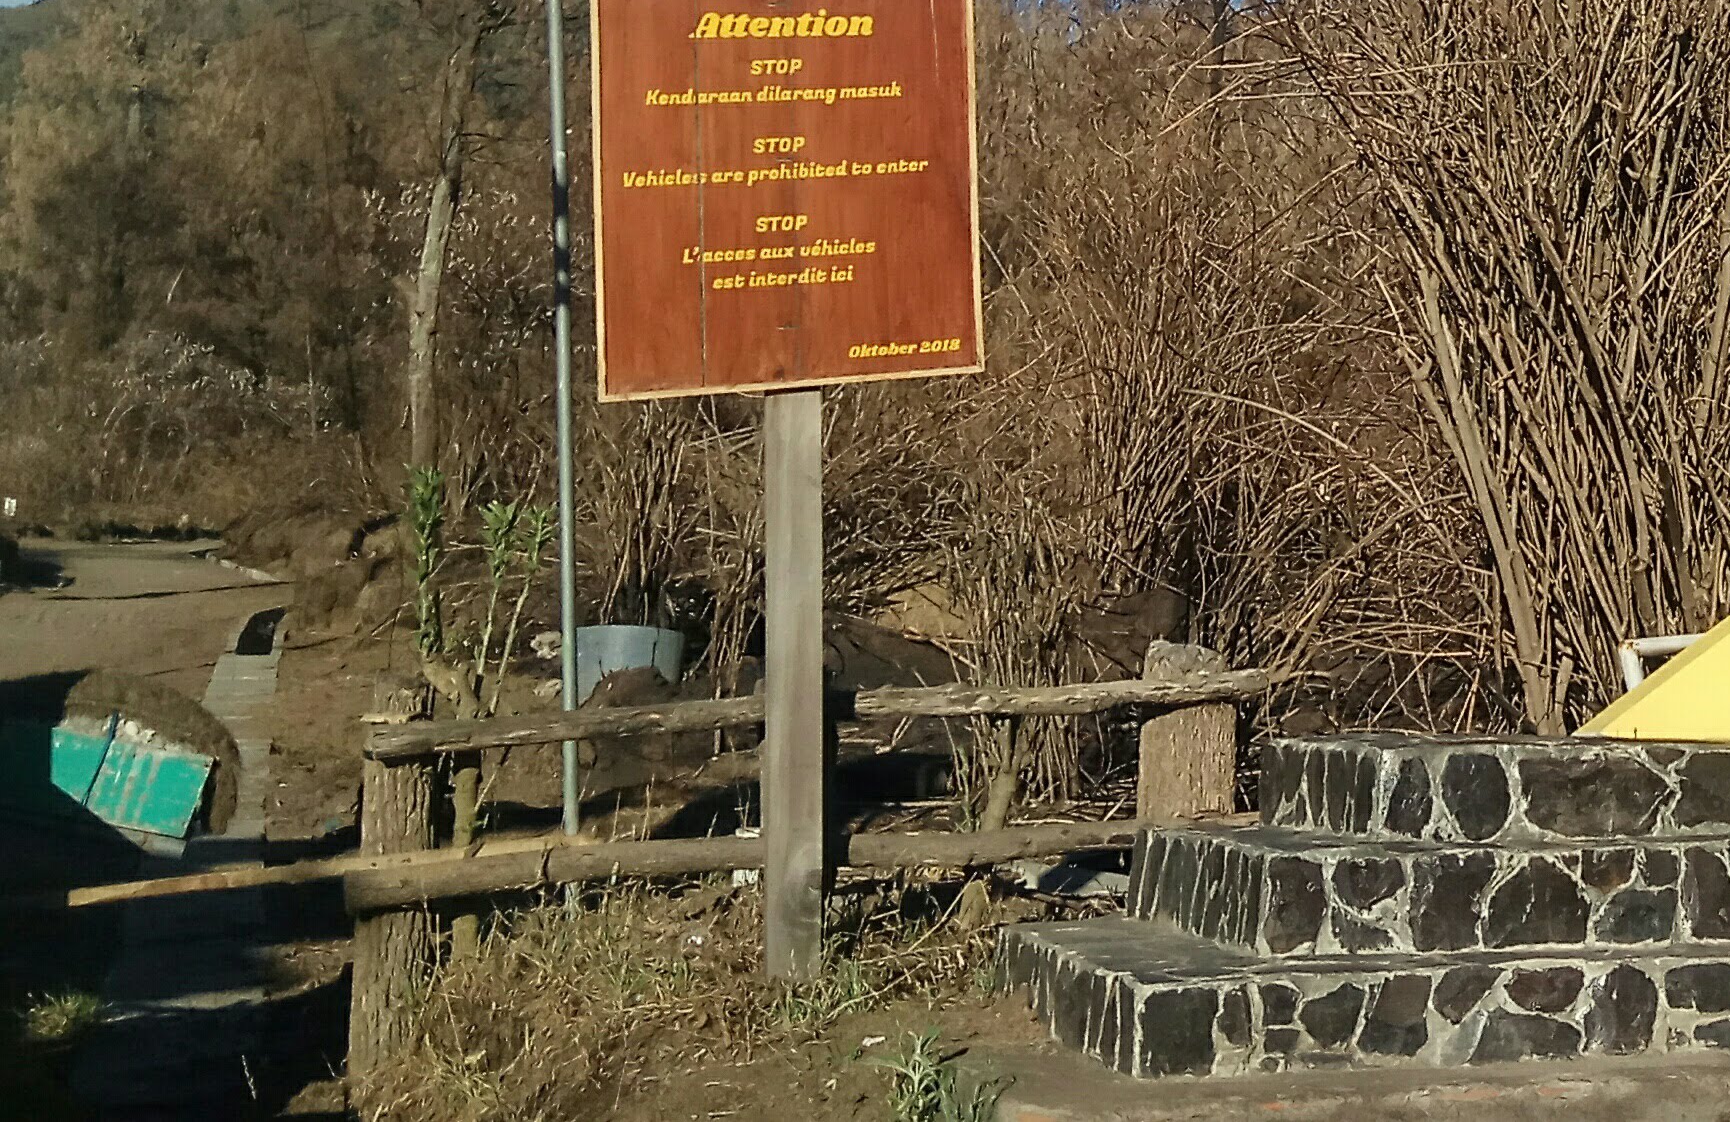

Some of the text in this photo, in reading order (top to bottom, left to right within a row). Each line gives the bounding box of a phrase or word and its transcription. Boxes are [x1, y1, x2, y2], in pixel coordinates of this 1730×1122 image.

[688, 8, 874, 38] Attention
[750, 58, 803, 76] STOP
[756, 83, 836, 105] dilarang
[839, 81, 902, 100] masuk
[752, 136, 806, 154] STOP
[623, 159, 929, 188] Vehicles are prohibited to enter
[755, 215, 808, 233] STOP
[760, 245, 795, 260] aux
[800, 238, 876, 257] véhicles
[712, 265, 854, 289] est interdit ici
[848, 337, 961, 358] Oktober 2018
